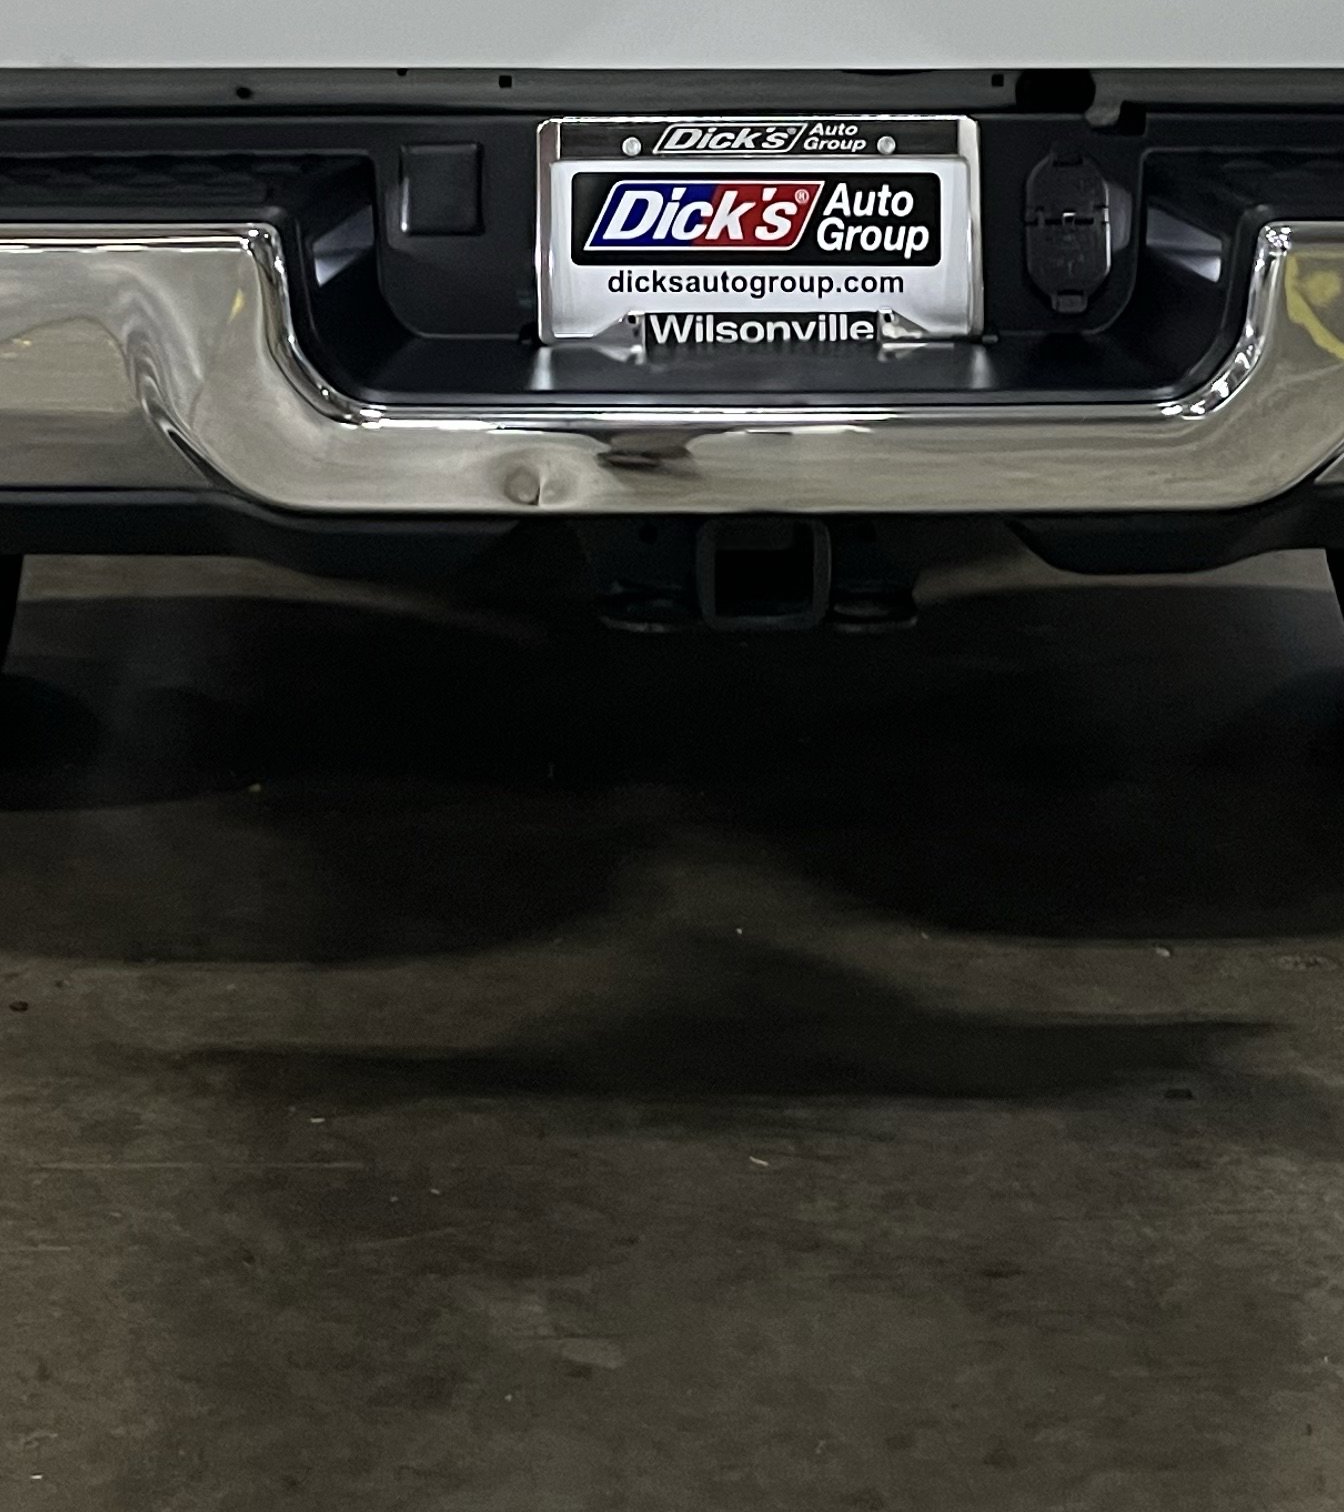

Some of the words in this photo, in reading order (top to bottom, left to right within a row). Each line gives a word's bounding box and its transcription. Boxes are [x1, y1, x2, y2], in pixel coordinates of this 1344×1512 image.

[663, 127, 790, 150] Dick's
[809, 122, 858, 136] Auto
[803, 136, 867, 153] Group
[602, 186, 798, 242] Dick's
[823, 183, 914, 218] Auto
[816, 219, 930, 260] Group
[607, 269, 904, 298] dicksautogroup.com
[649, 313, 874, 344] Wilsonville
